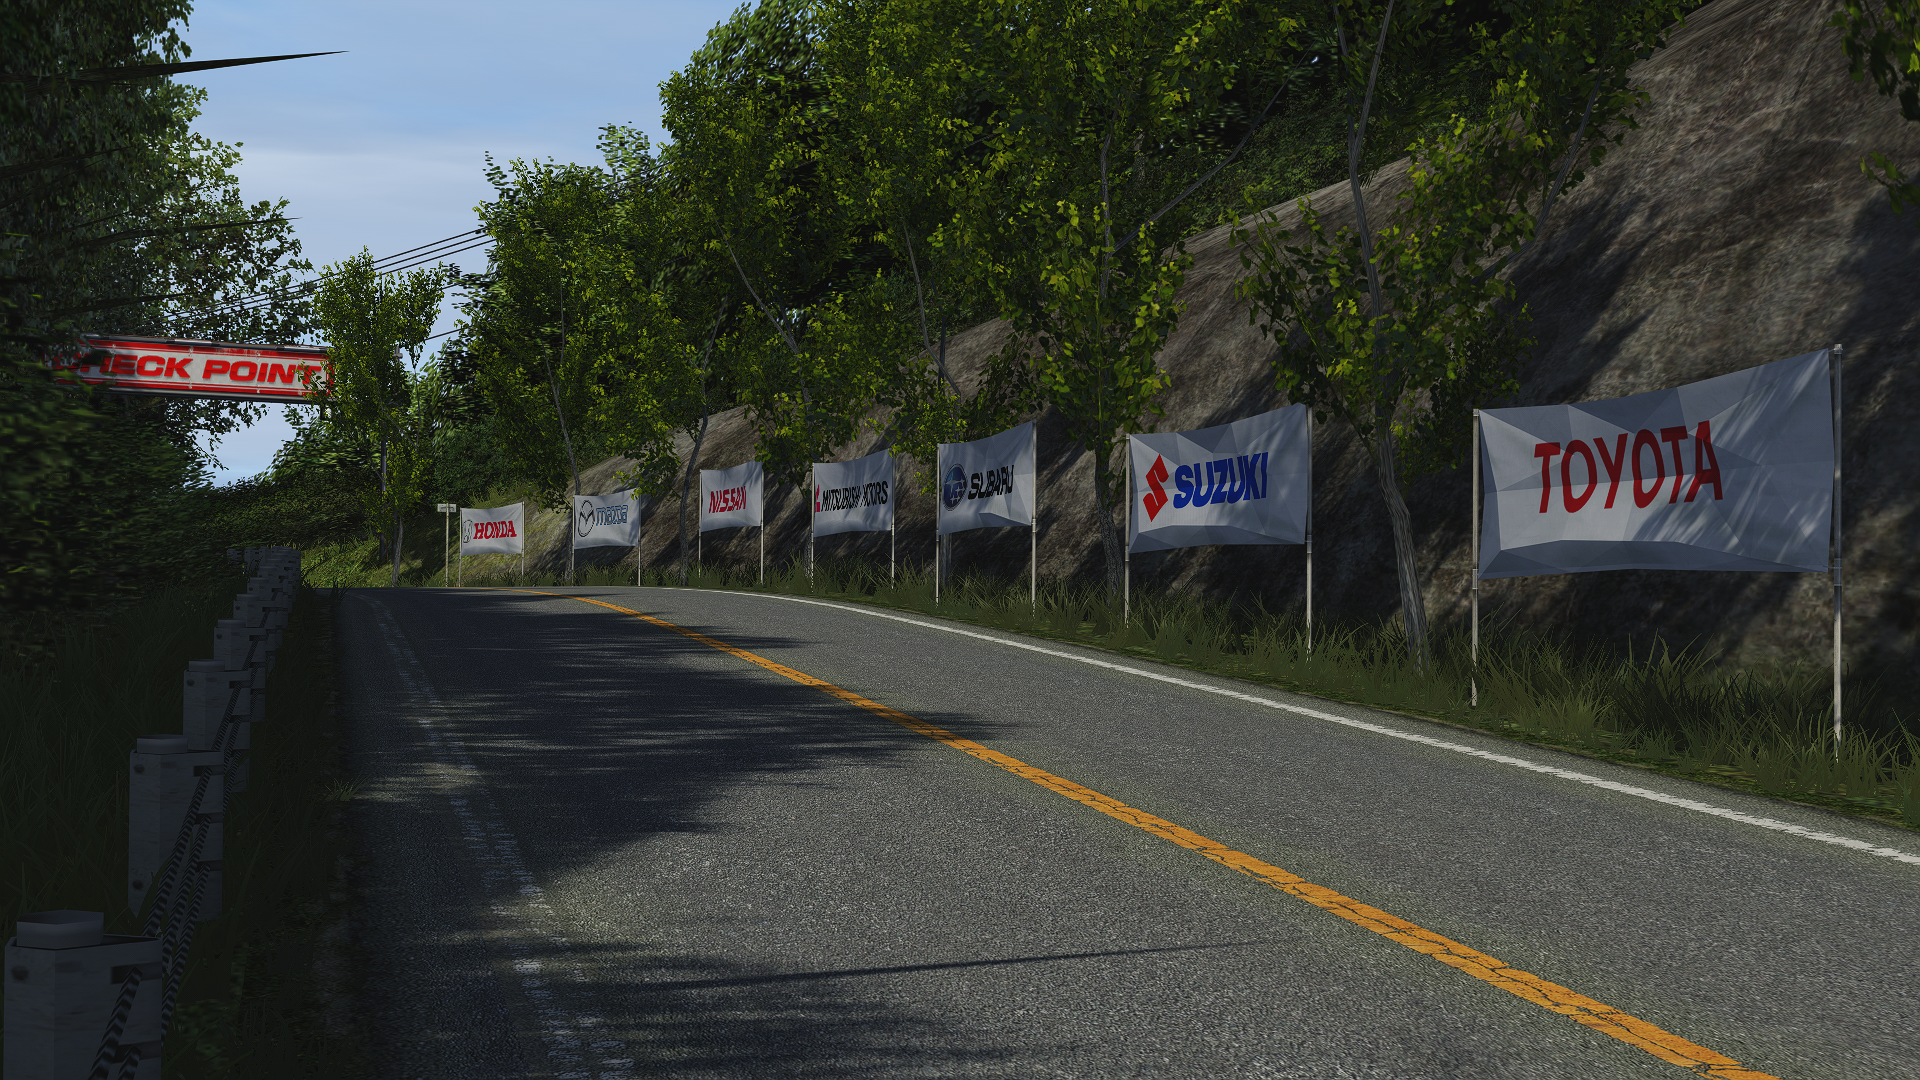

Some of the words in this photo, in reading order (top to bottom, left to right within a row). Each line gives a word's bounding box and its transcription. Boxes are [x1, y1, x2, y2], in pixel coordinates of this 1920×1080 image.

[203, 359, 322, 385] POINT
[968, 464, 1015, 500] SUBARU
[1173, 451, 1268, 509] SUZUKI
[1534, 420, 1723, 513] TOYOTA
[709, 485, 746, 513] NISSAN
[473, 520, 517, 539] HONDA
